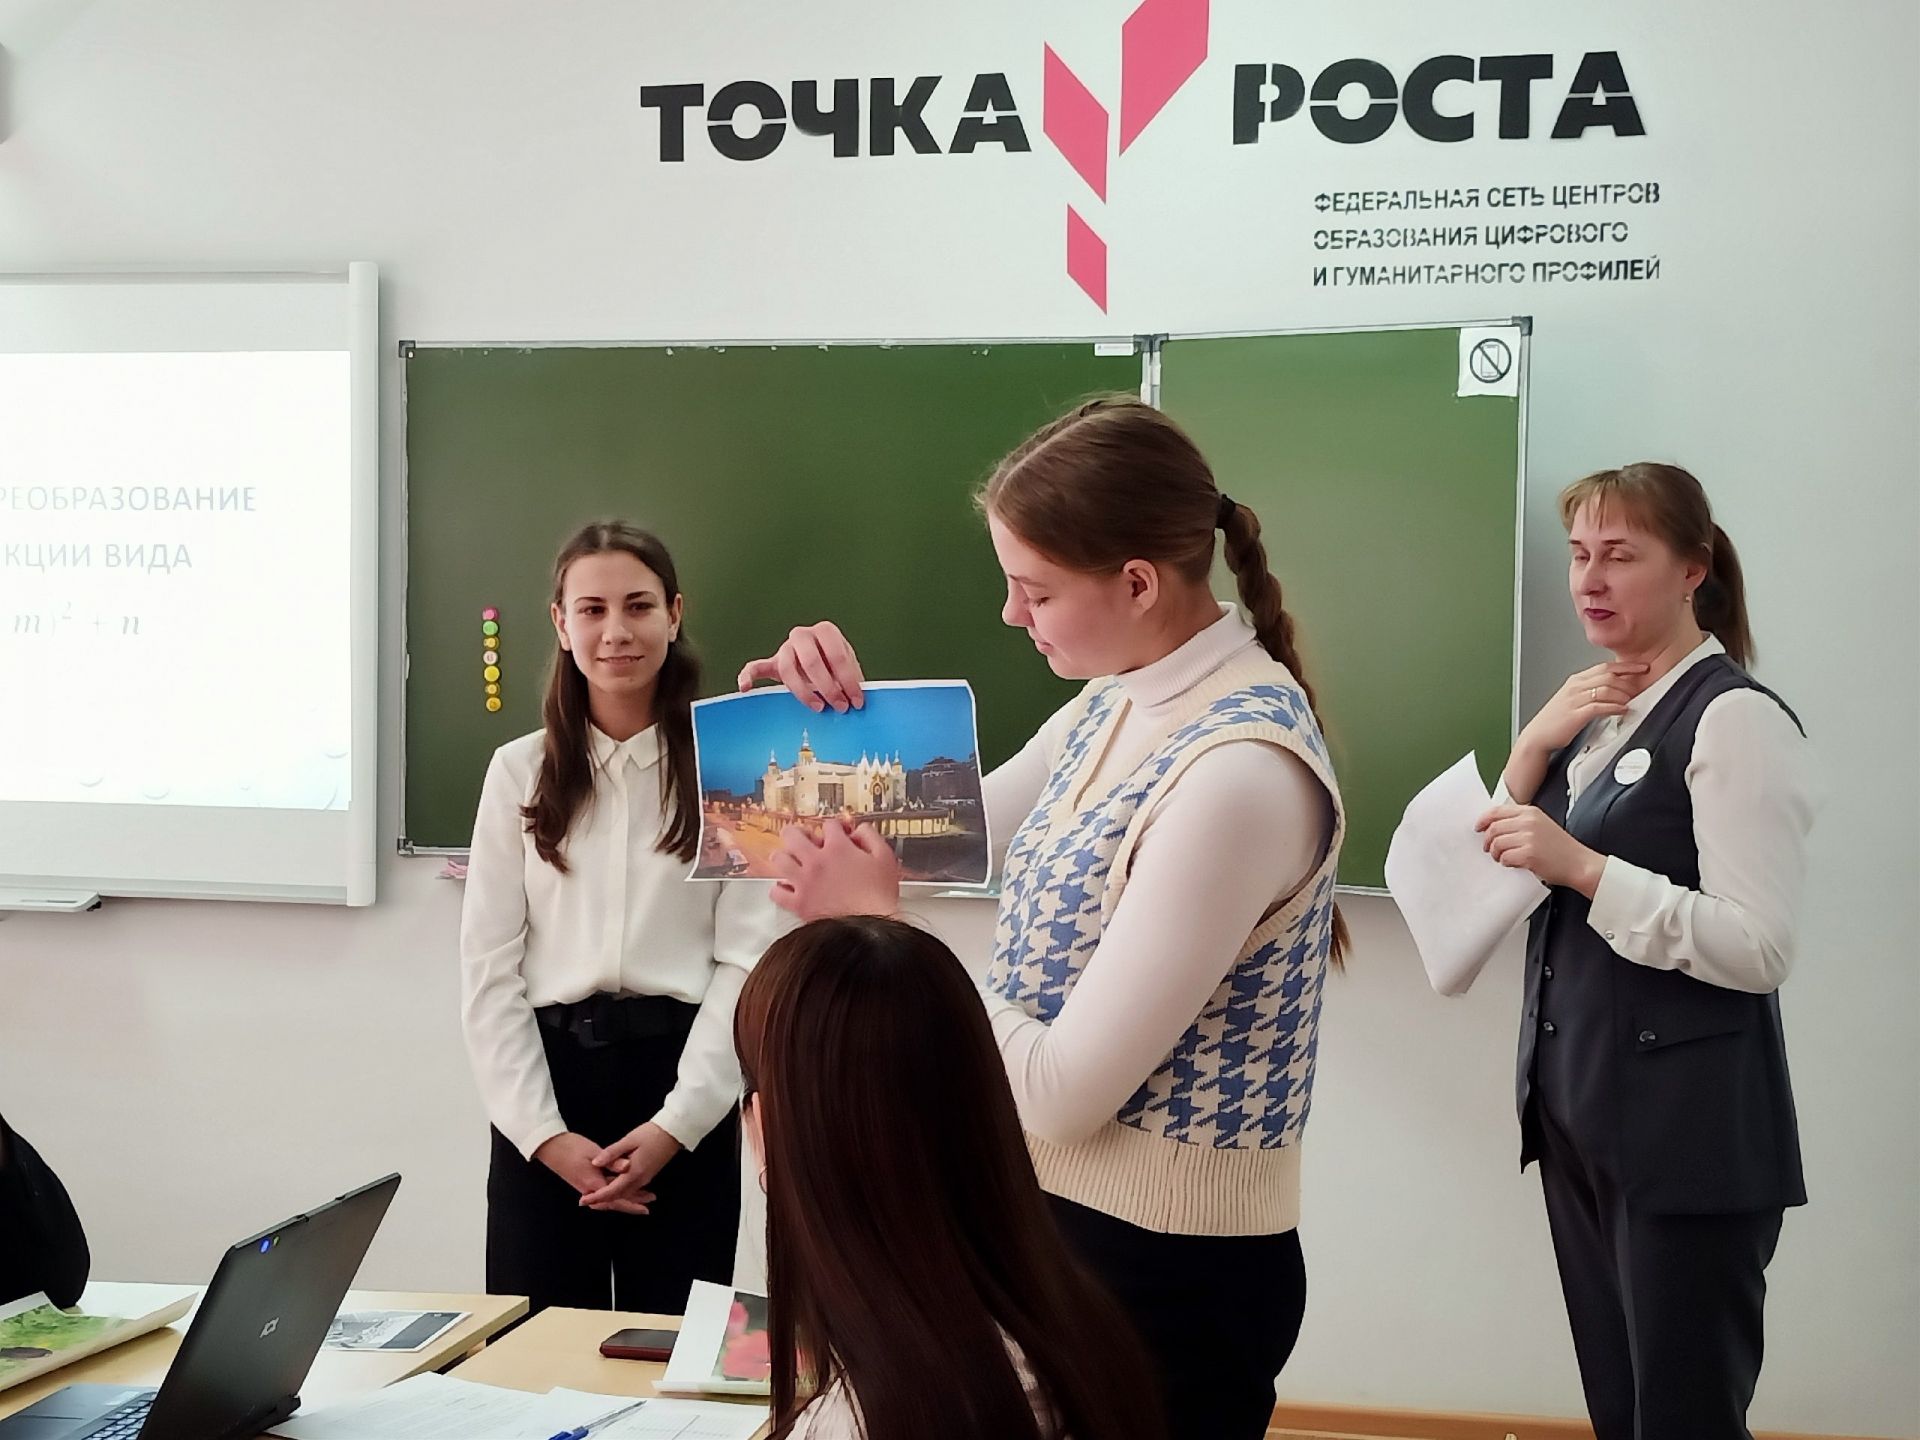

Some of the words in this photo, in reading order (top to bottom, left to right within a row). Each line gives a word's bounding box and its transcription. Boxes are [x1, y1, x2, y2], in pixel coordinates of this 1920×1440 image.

[639, 72, 1032, 163] ТОЧКА
[1232, 50, 1648, 146] РОСТА
[1313, 188, 1480, 214] ФЕДЕРАЛЬНАЯ
[1486, 185, 1545, 208] СЕТЬ
[1552, 182, 1661, 210] ЦЕНТРОВ
[1313, 225, 1478, 251] ОБРАЗОВАНИЯ
[1484, 221, 1629, 250] ЦИФРОВОГО
[1313, 266, 1327, 287] И
[1333, 262, 1526, 287] ГУМАНИТАРНОГО
[1532, 254, 1661, 283] ПРОФИЛЕЙ
[105, 543, 193, 576] ВИДА
